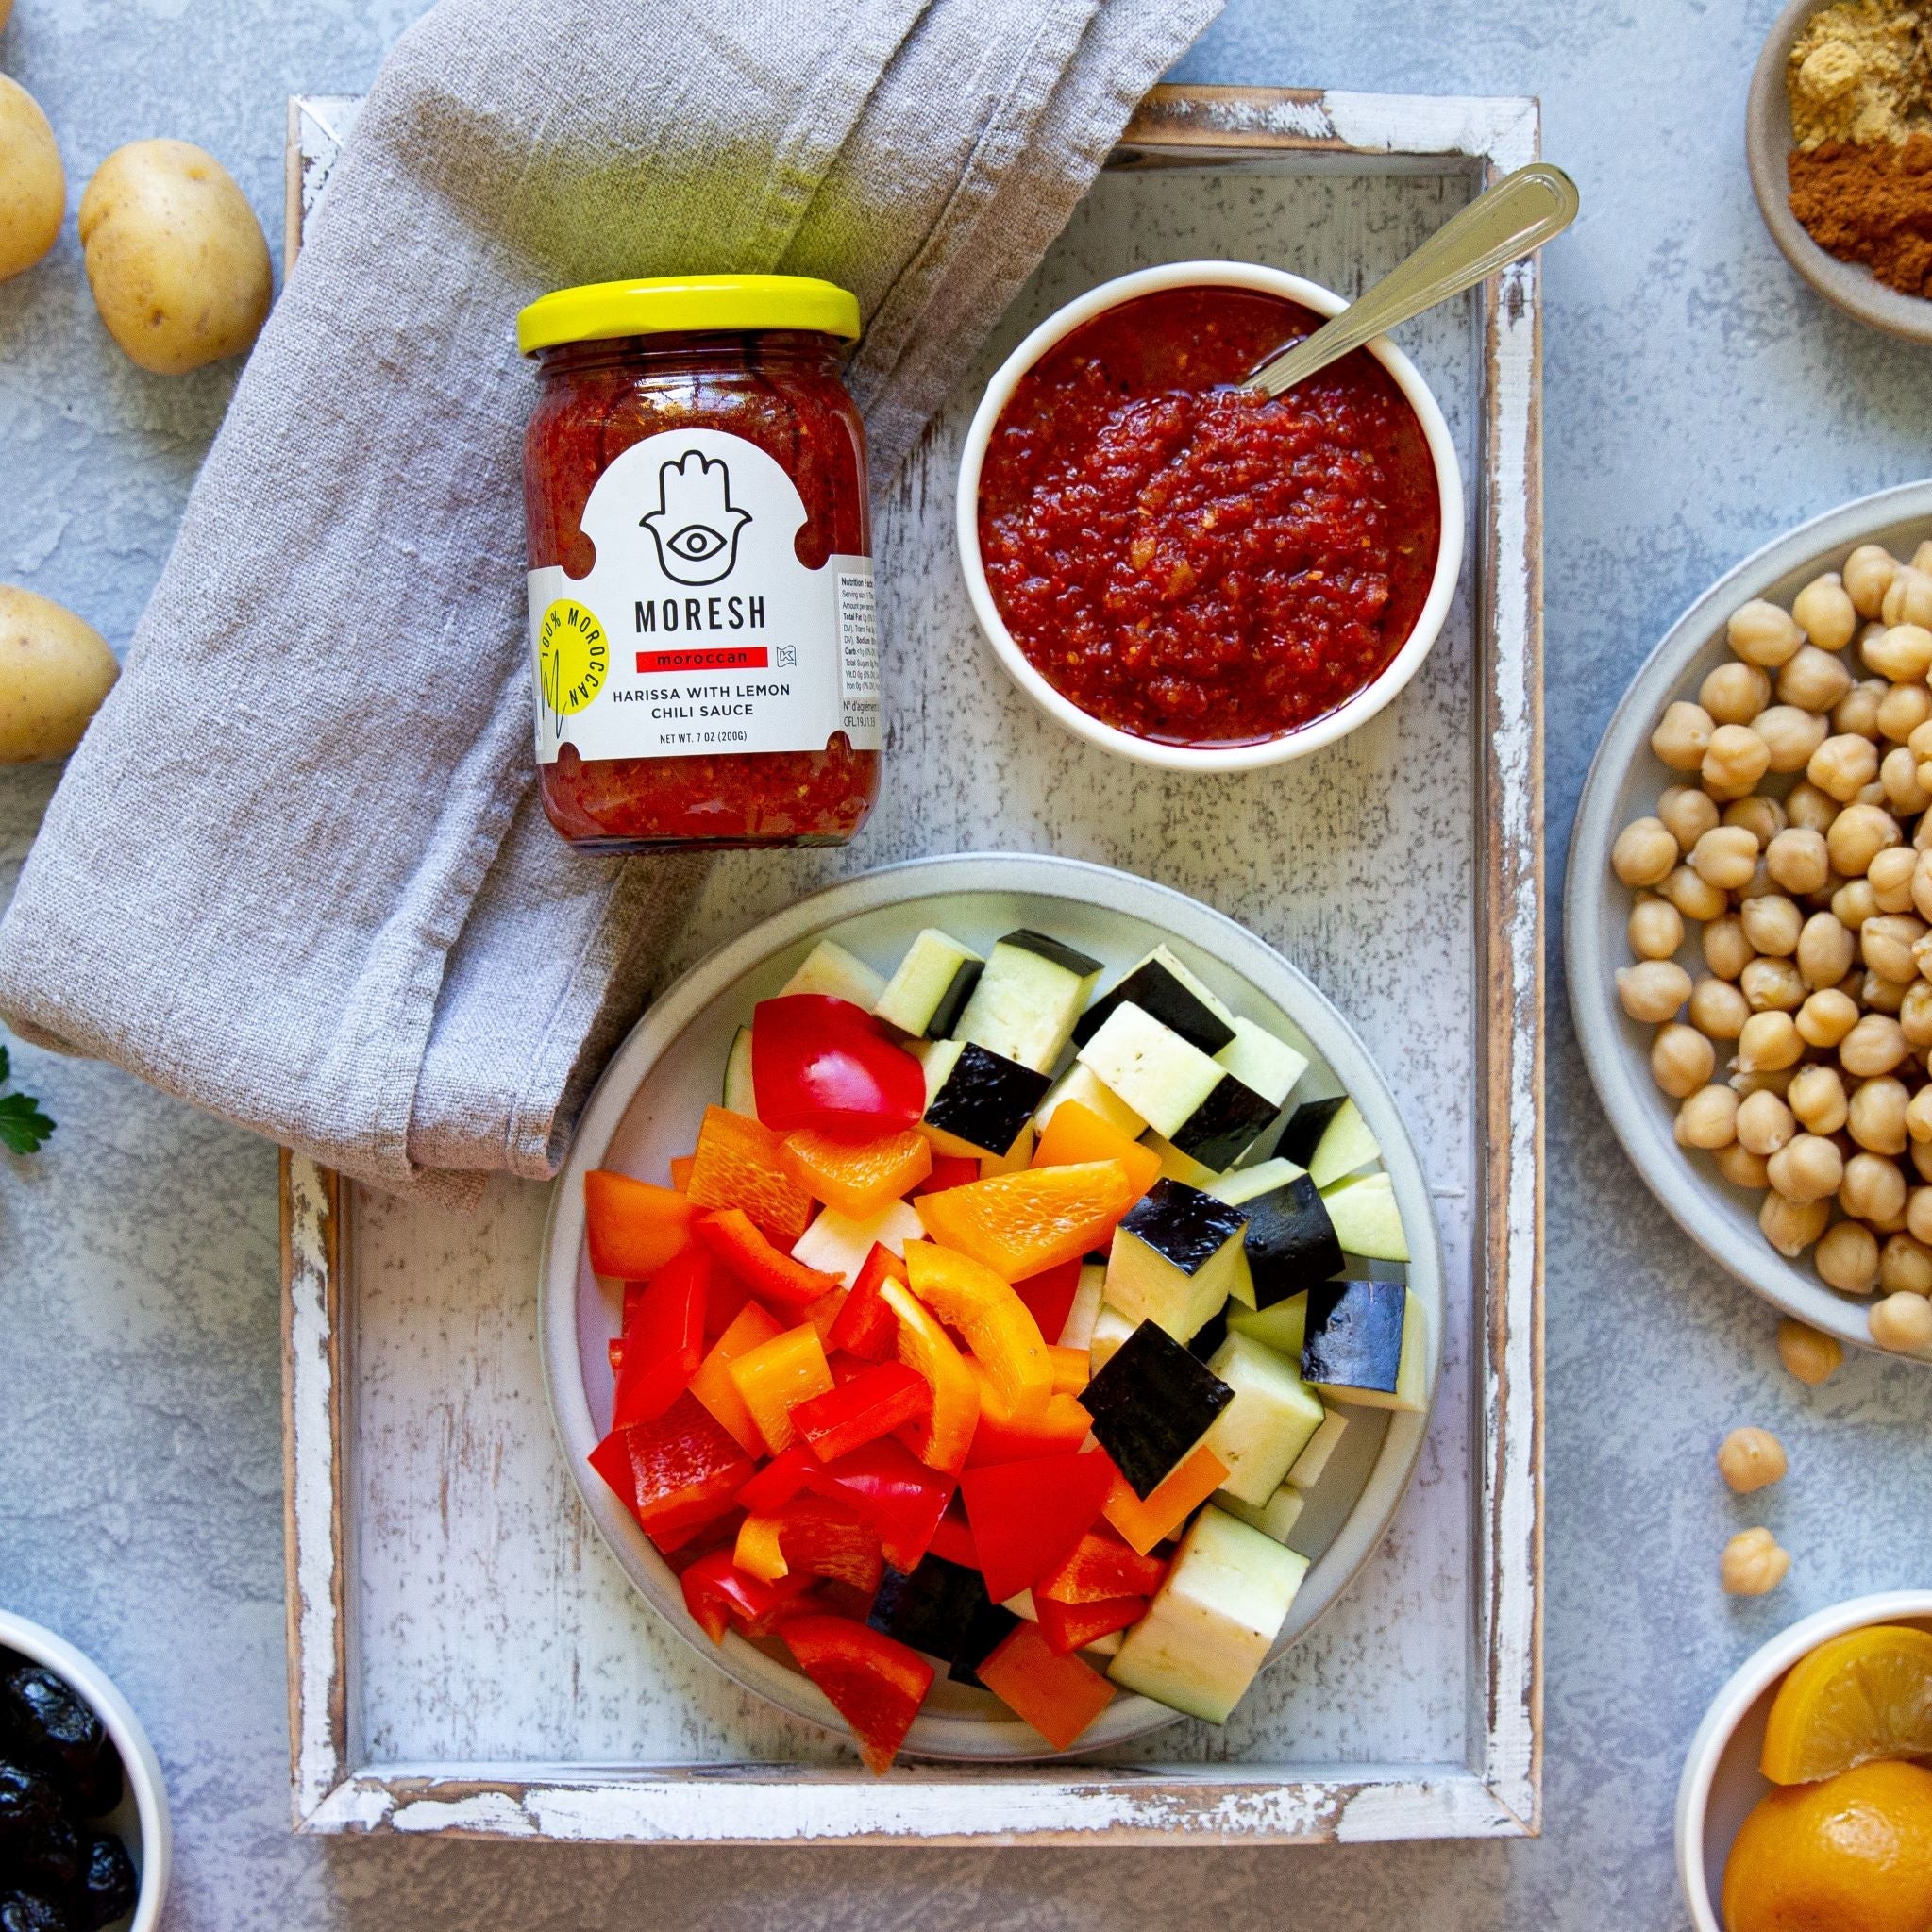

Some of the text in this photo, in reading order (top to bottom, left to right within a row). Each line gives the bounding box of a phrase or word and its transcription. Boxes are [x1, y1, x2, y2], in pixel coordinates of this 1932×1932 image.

[841, 577, 864, 586] Nutrition
[635, 596, 765, 633] MORESH
[542, 607, 606, 707] 100% MOROCCAN
[657, 651, 748, 665] moroccan
[613, 684, 790, 702] HARISSA WITH LEMON
[651, 704, 753, 719] CHILI SAUCE
[660, 731, 748, 744] NET WT. 7 OZ (200G)
